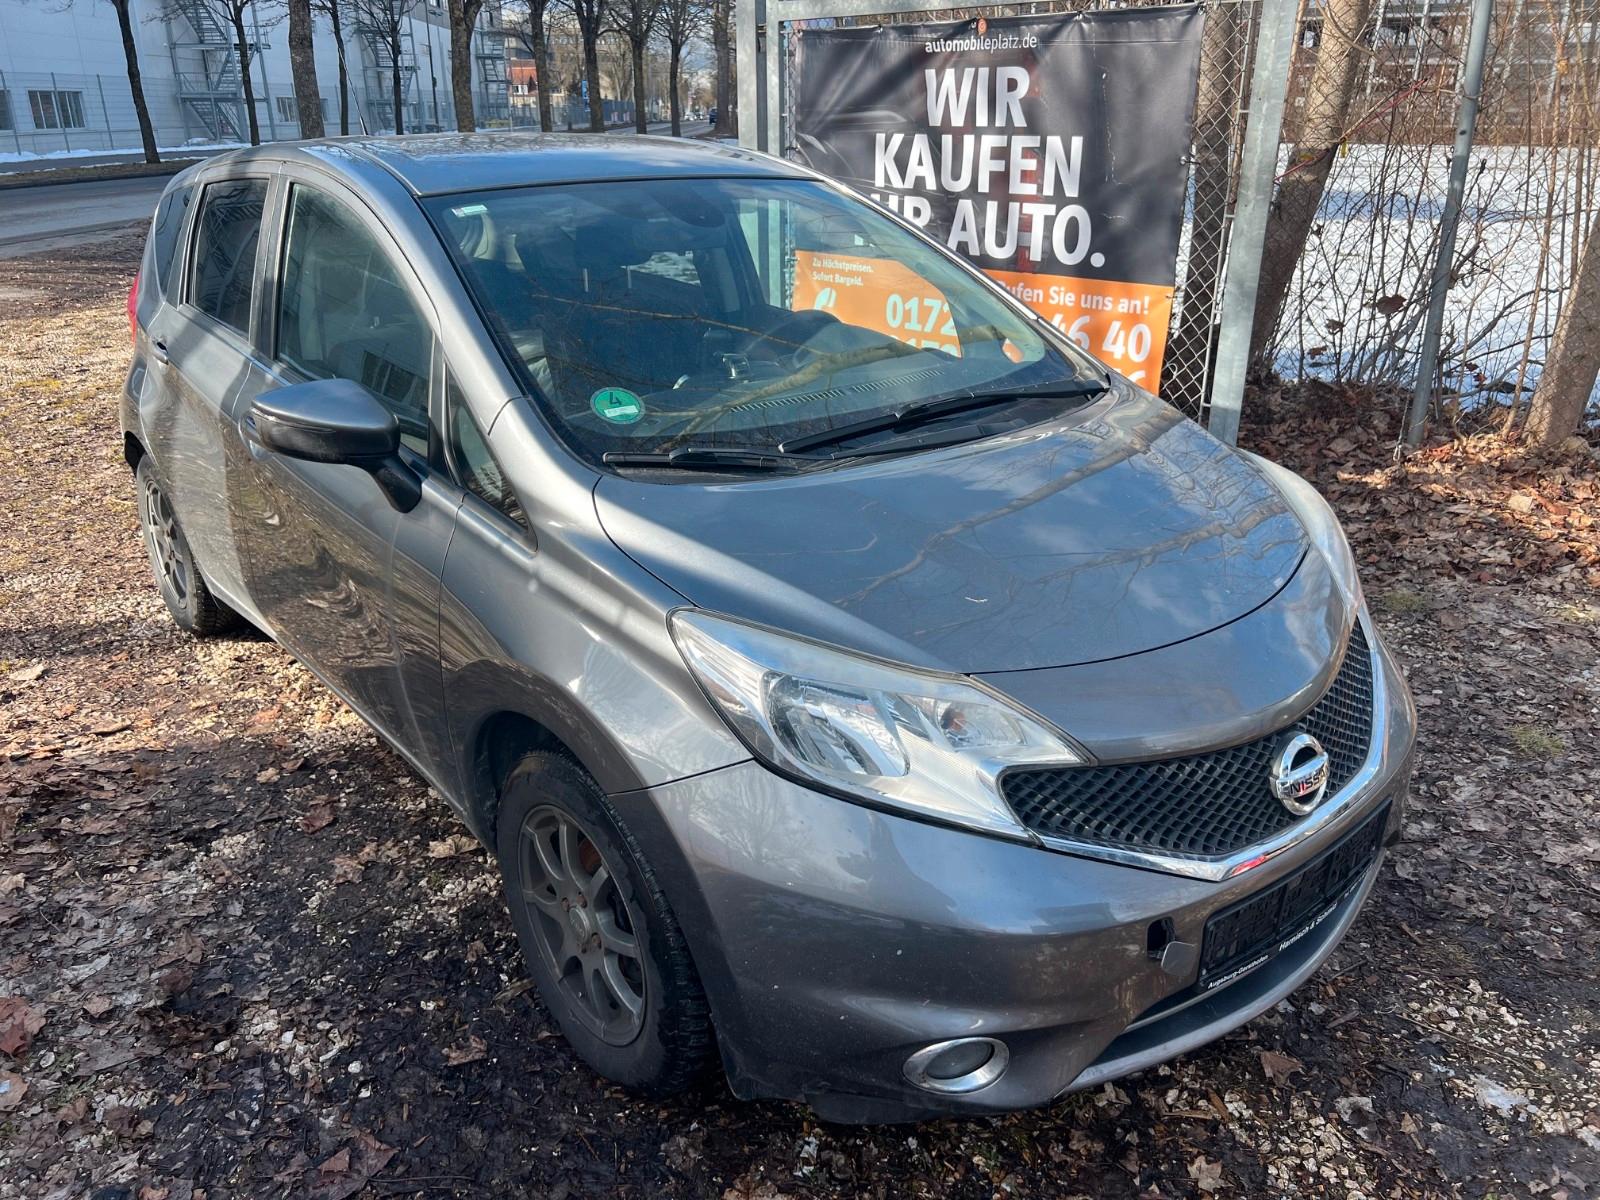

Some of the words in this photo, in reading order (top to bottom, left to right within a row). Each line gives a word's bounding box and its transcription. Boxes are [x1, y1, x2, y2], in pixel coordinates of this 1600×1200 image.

[925, 33, 1038, 54] automobileplatz.de
[925, 66, 1030, 128] WIR
[874, 133, 1084, 197] KAUFEN
[947, 199, 1106, 268] AUTO.
[812, 257, 821, 268] Zu
[823, 258, 874, 273] Höchstpreisen.
[812, 271, 833, 282] Sofort
[835, 273, 864, 286] Bargeld.
[1048, 286, 1075, 307] Sie
[1080, 293, 1113, 311] uns
[1118, 295, 1151, 315] an!
[1102, 320, 1152, 363] 40
[609, 391, 622, 405] 4
